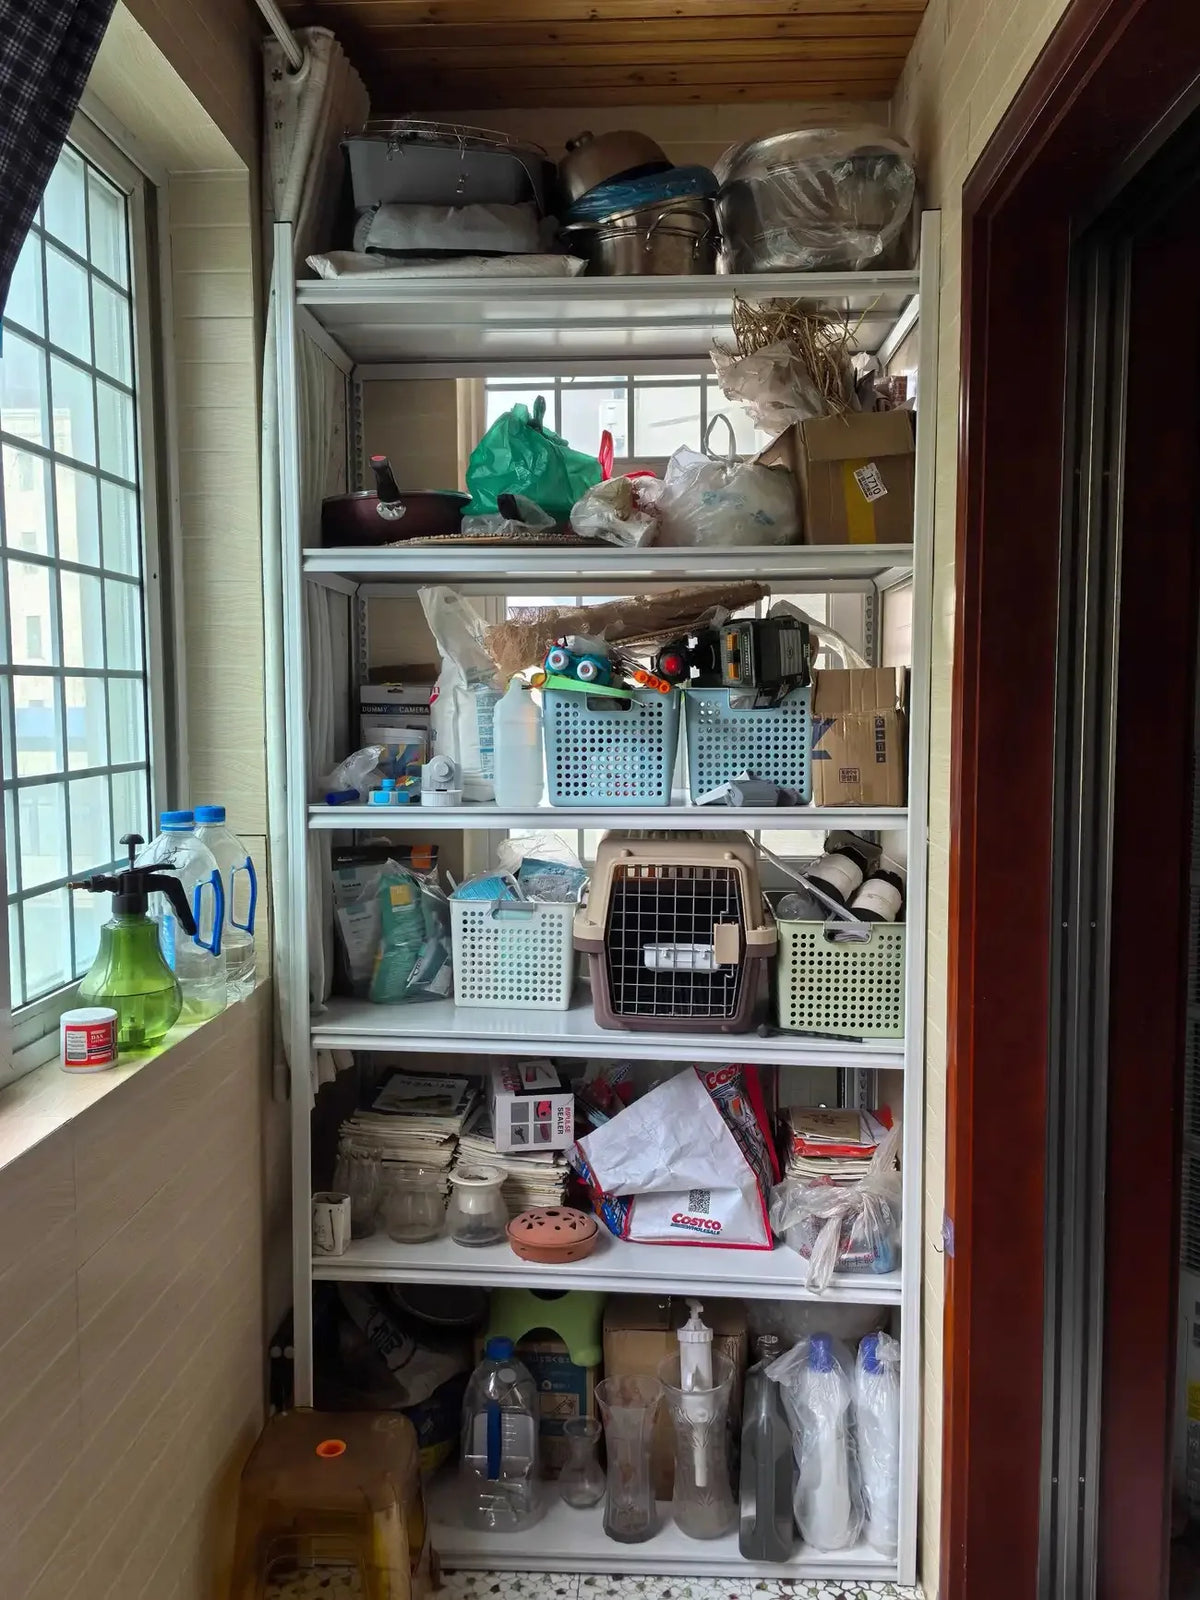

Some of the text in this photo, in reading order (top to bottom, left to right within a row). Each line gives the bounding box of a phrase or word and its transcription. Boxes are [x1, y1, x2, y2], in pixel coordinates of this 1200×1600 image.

[865, 473, 881, 495] 1710
[671, 1213, 722, 1231] COSTCO
[686, 1225, 721, 1235] WHOLESALE
